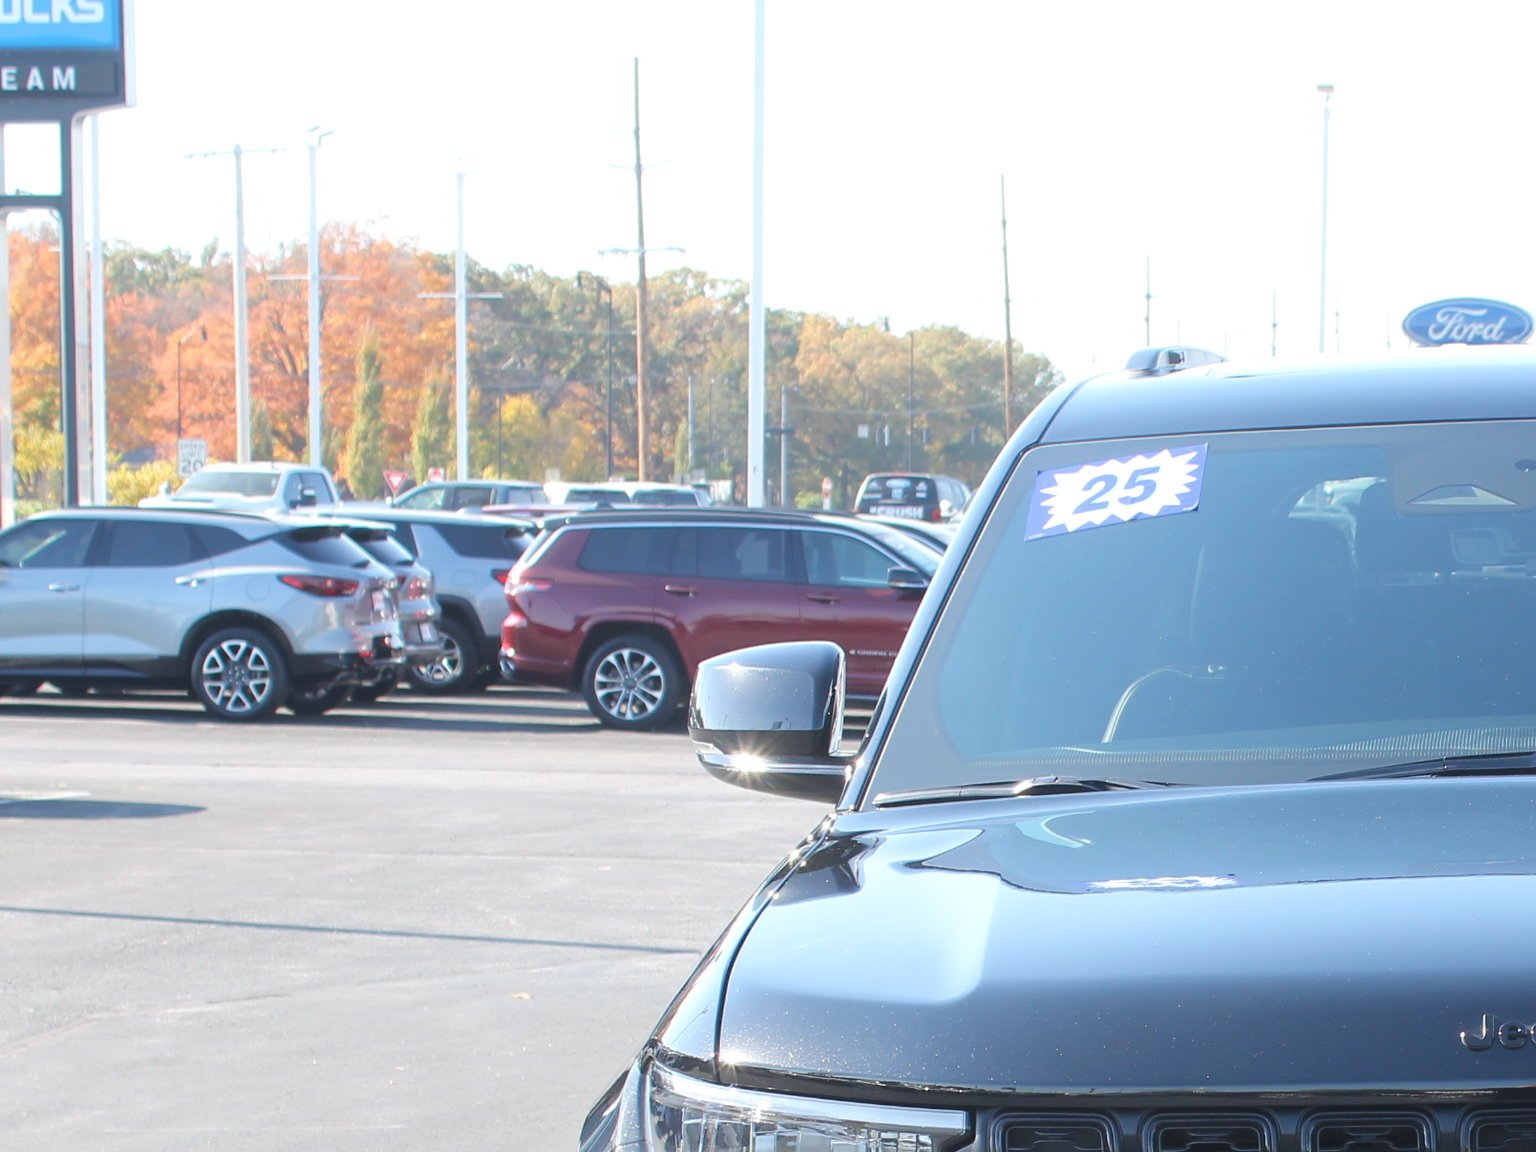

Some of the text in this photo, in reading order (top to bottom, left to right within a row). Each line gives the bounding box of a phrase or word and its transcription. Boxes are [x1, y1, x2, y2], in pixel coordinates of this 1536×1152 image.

[1, 66, 76, 90] EAM
[1428, 306, 1507, 341] Ford
[1072, 466, 1160, 514] 25
